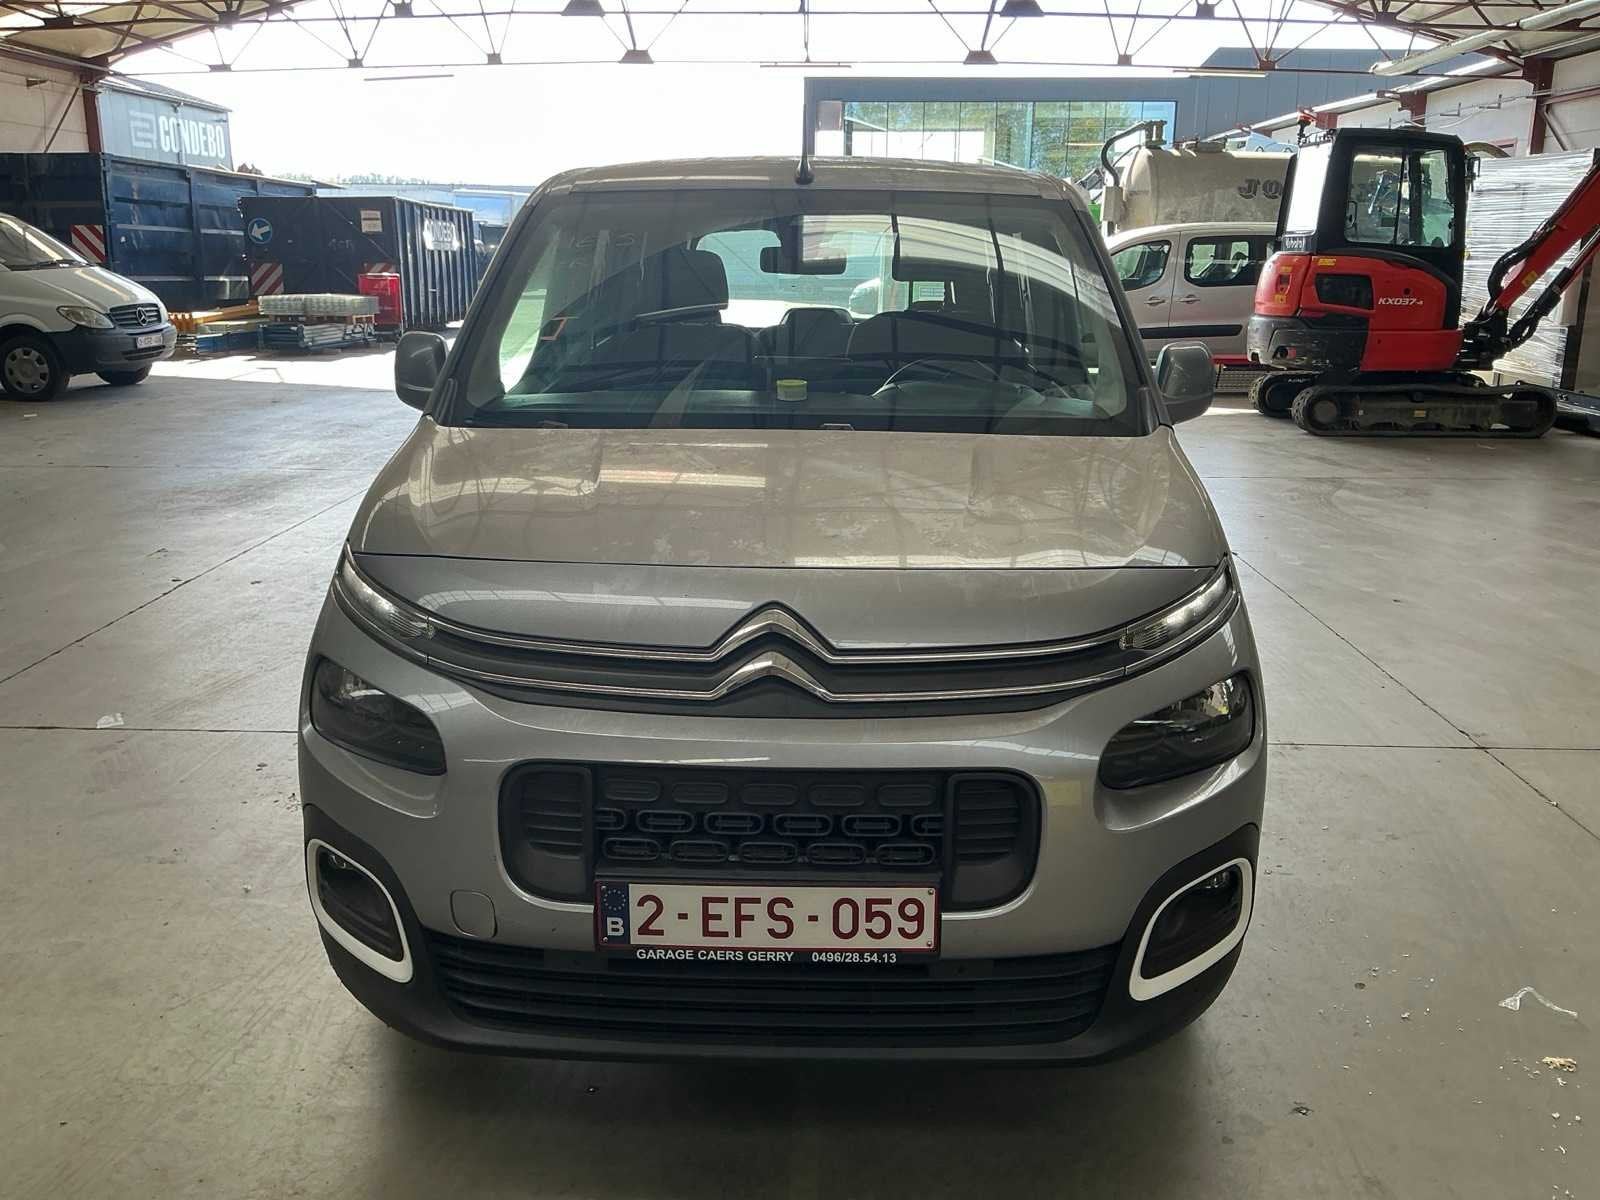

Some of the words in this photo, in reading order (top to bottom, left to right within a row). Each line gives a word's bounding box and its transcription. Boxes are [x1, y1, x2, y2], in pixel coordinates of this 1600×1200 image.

[159, 115, 226, 159] CONDEBO
[607, 917, 625, 936] B
[636, 949, 694, 960] GARAGE
[698, 951, 744, 961] CAERS
[747, 951, 794, 962] GERRY
[811, 952, 897, 963] 0496/28.54.13
